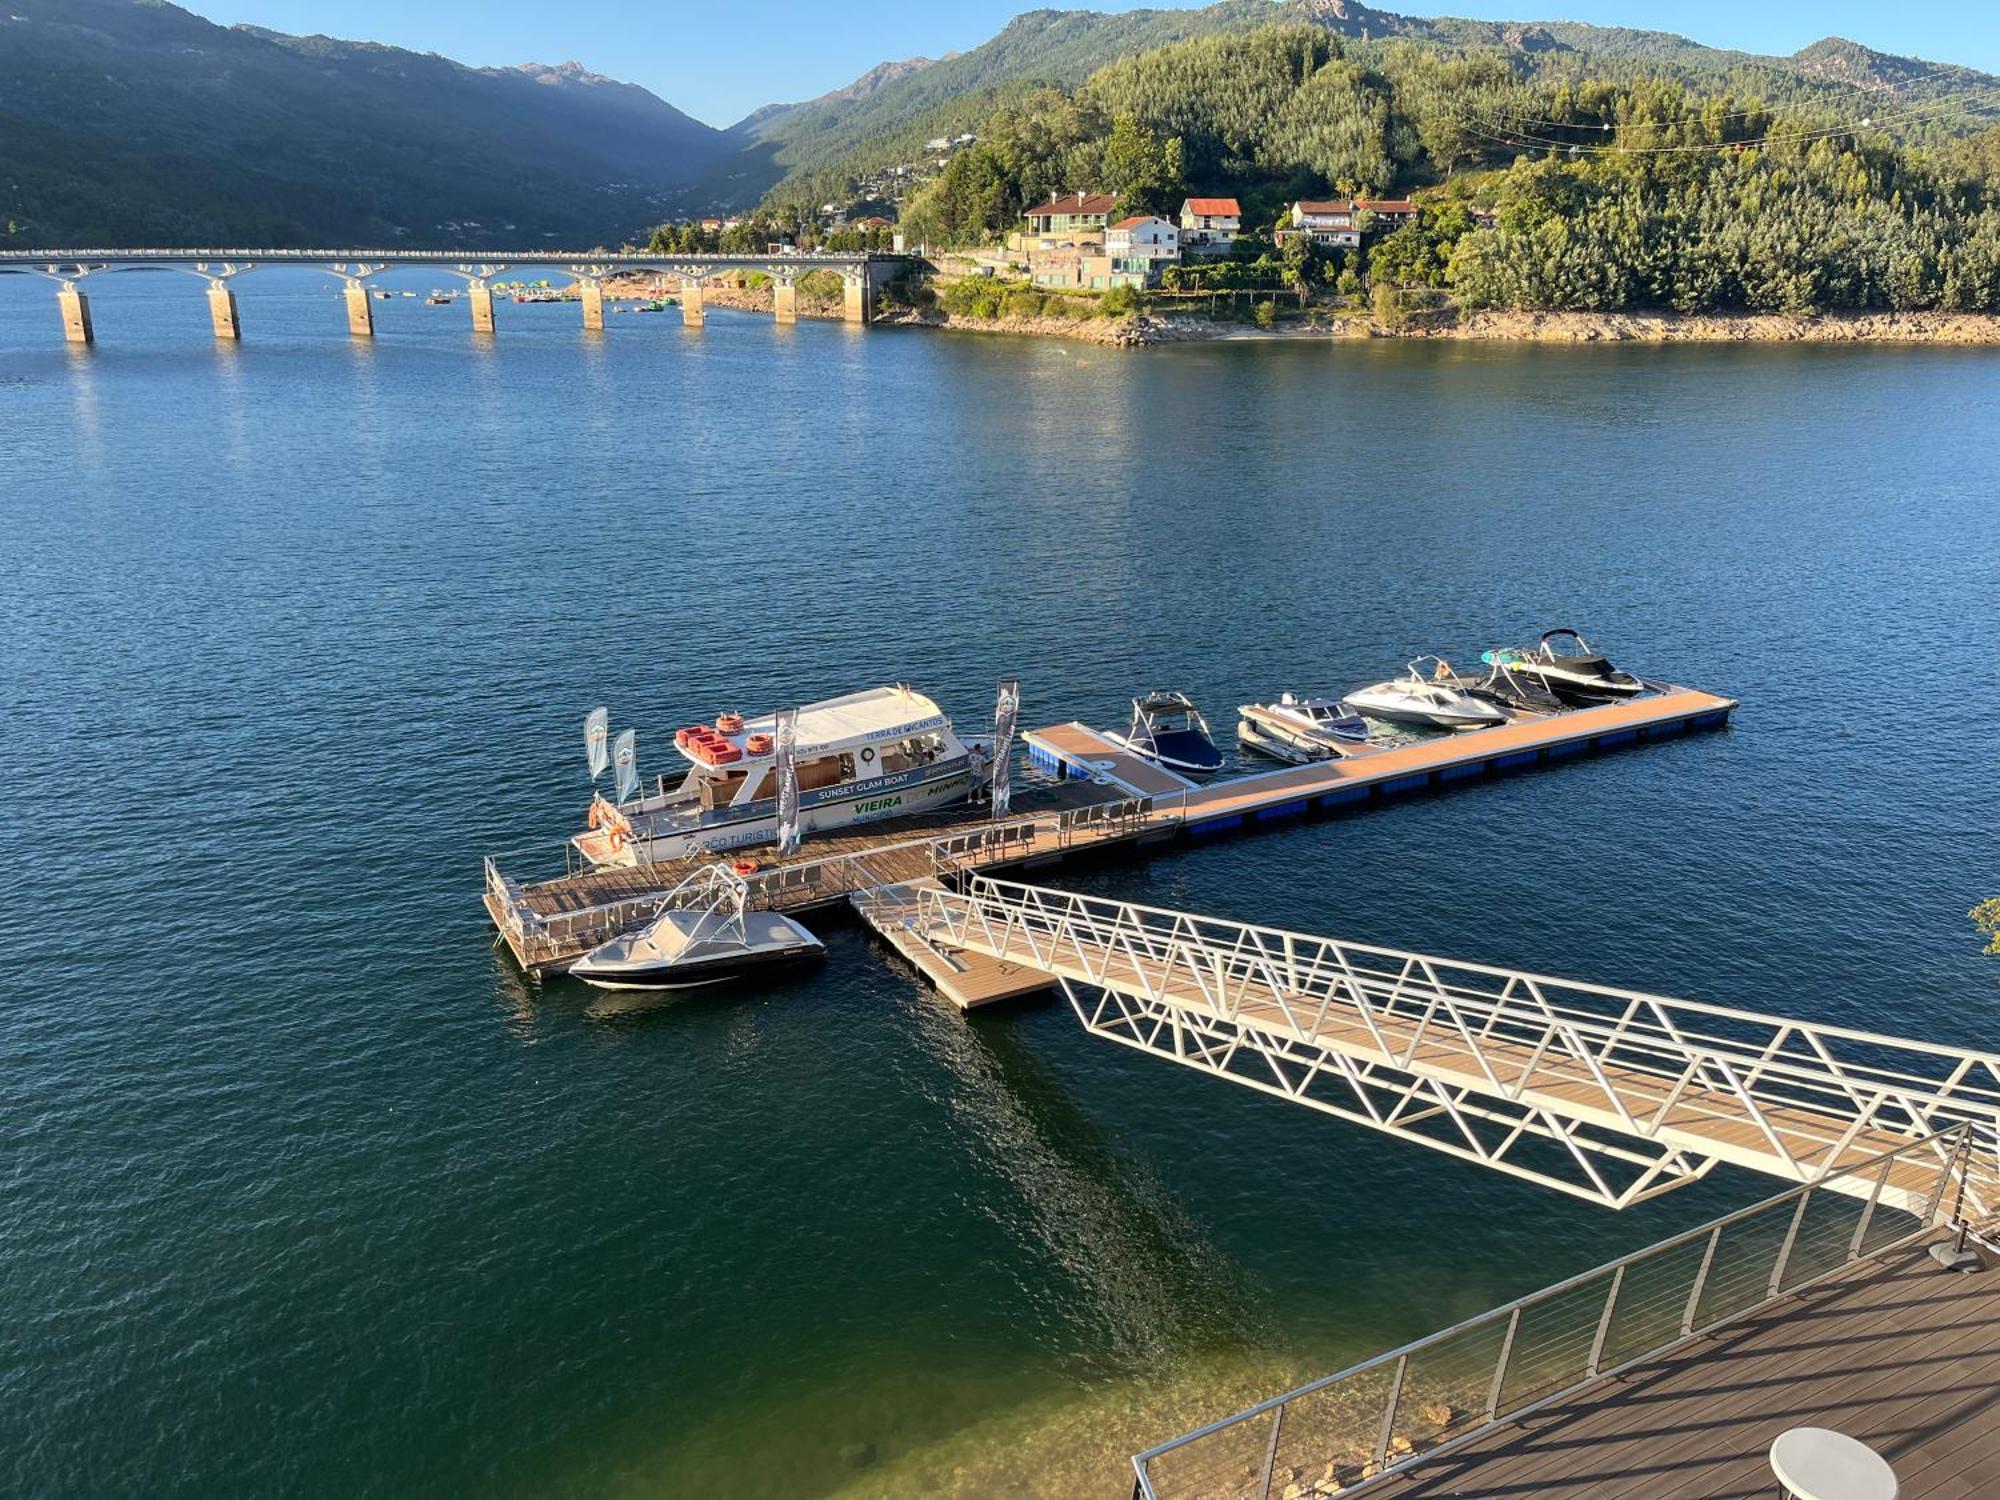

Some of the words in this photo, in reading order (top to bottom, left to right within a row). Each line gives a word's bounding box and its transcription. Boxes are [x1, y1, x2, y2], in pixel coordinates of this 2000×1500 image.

[866, 729, 892, 742] TERRA
[892, 726, 902, 737] DE
[818, 785, 855, 800] SUNSET
[856, 779, 882, 792] GLAM
[884, 774, 909, 786] BOAT
[854, 796, 903, 814] VIEIRA
